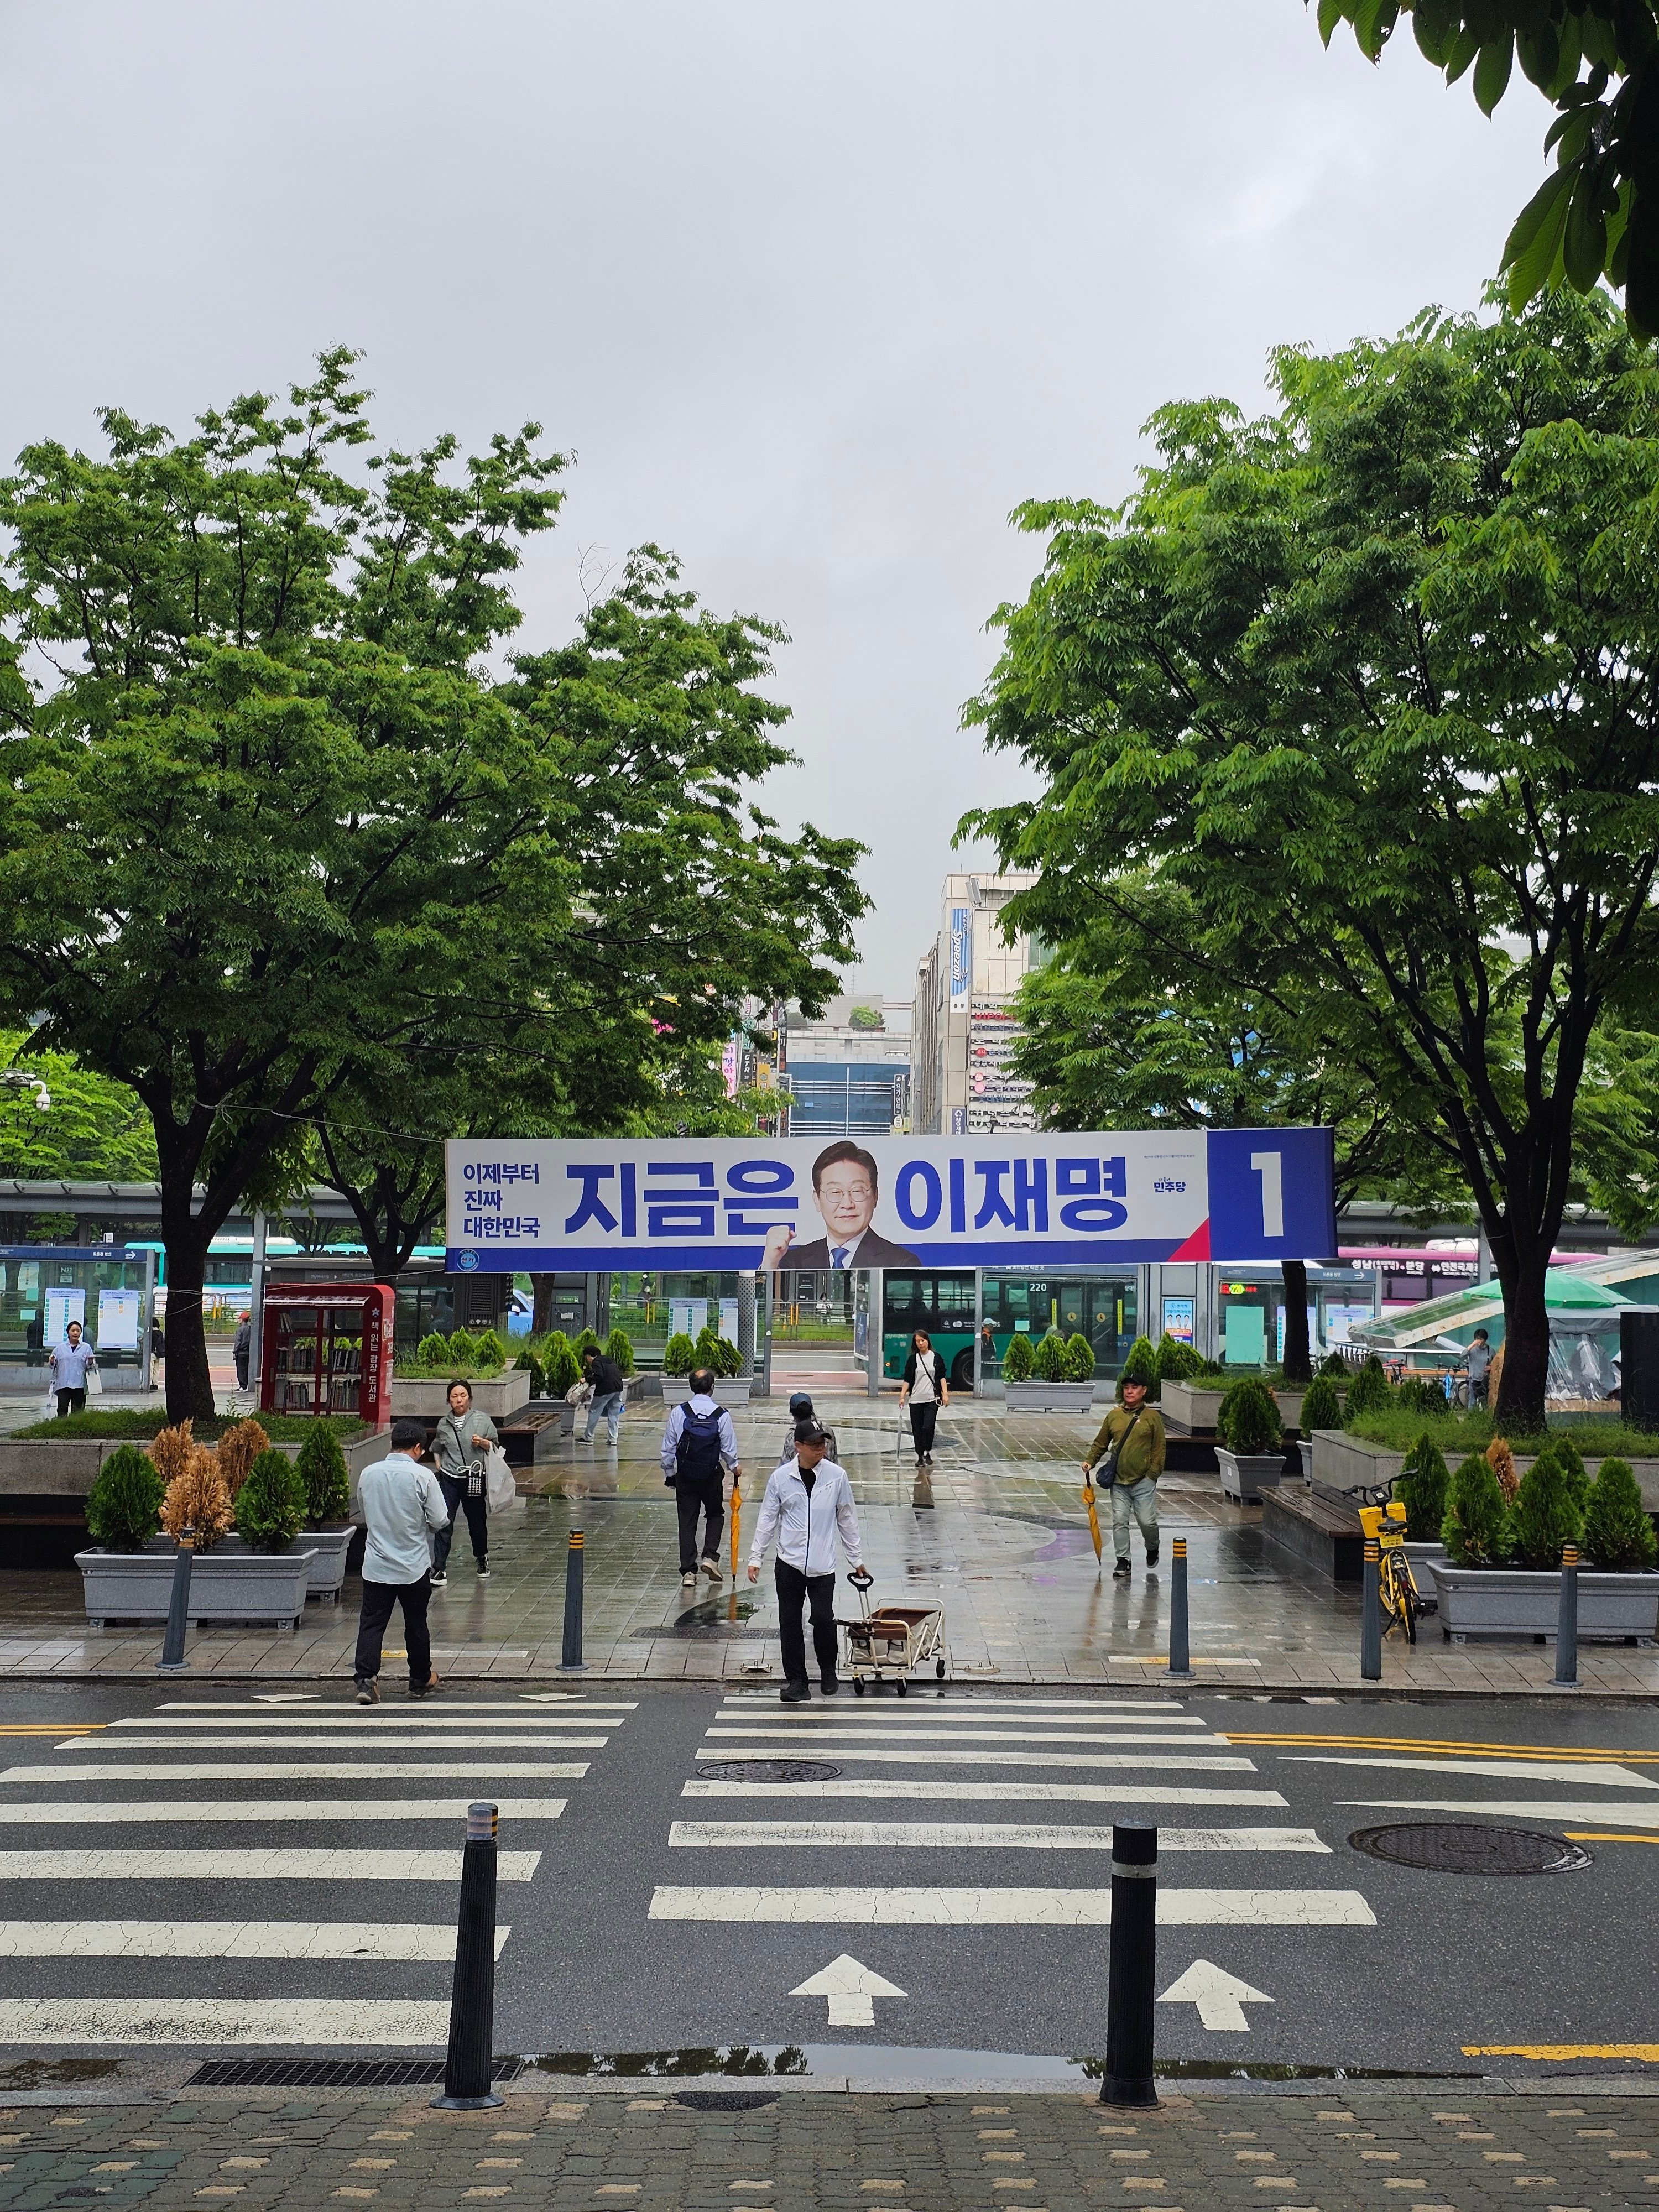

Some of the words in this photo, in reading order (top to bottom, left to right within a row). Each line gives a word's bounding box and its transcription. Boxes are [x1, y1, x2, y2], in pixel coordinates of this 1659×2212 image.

[952, 928, 963, 981] Speezon
[463, 1163, 539, 1185] 이제부터
[894, 1156, 1128, 1233] 이재명
[1154, 1181, 1187, 1193] 민주당
[1250, 1152, 1284, 1237] 1
[463, 1190, 503, 1211] 진짜
[565, 1160, 799, 1238] 지금은
[463, 1217, 540, 1238] 대한민국
[1030, 1283, 1047, 1292] 220
[371, 1322, 379, 1331] 책
[370, 1333, 378, 1352] 읽는
[369, 1354, 378, 1373] 광장
[368, 1375, 377, 1402] 도서관
